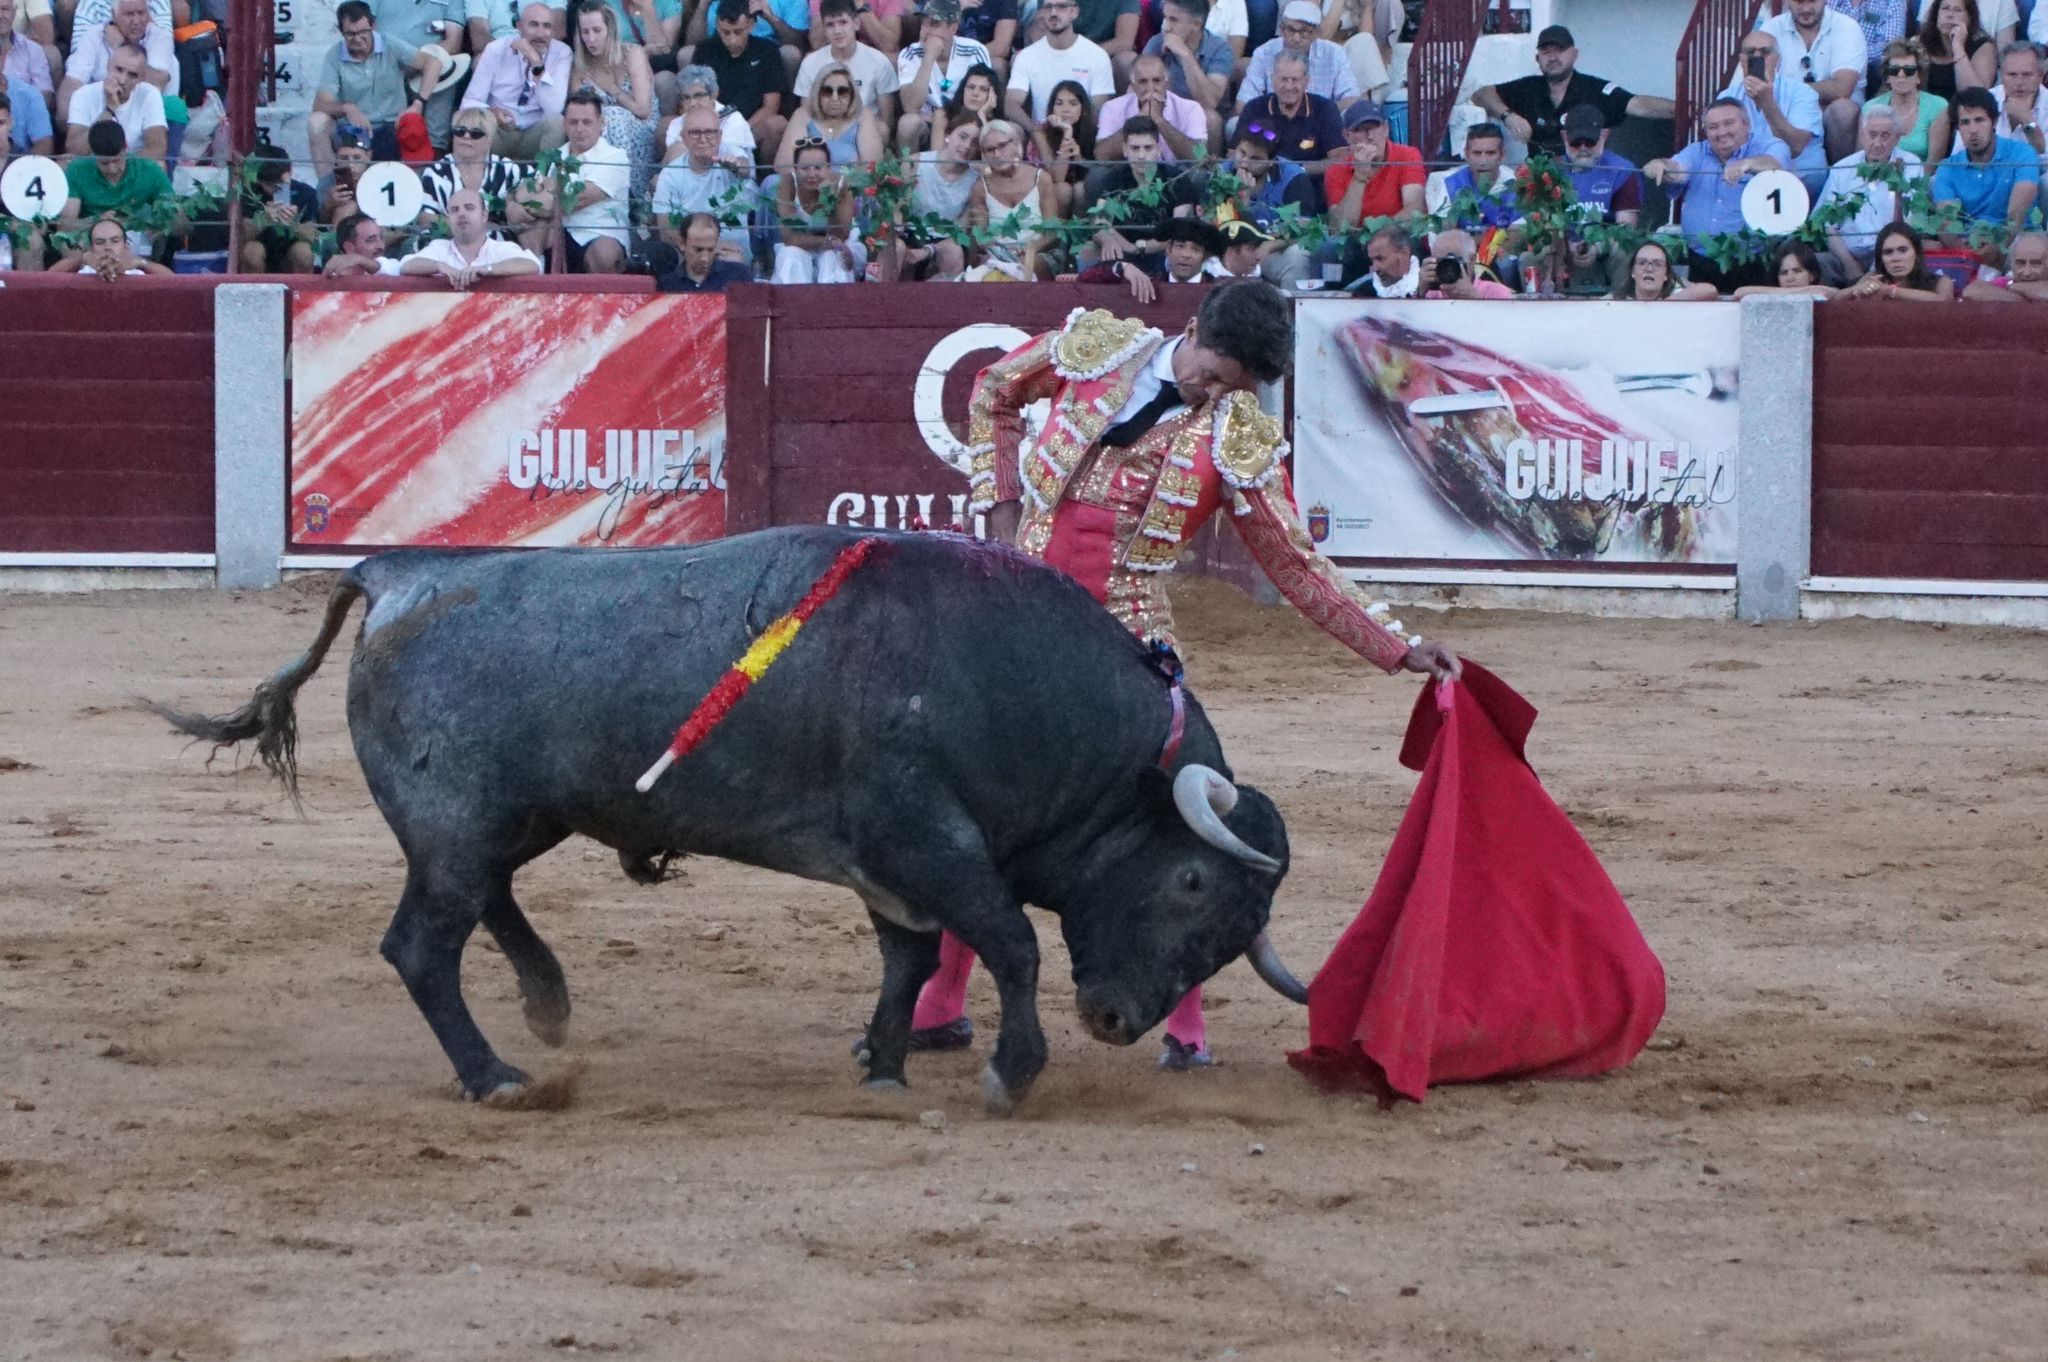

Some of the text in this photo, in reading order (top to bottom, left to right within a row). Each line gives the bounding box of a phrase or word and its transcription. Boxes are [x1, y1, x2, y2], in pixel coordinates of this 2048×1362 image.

[274, 2, 292, 22] 5
[25, 175, 46, 201] 4
[381, 182, 396, 206] 1
[1766, 188, 1782, 214] 1
[1505, 439, 1737, 503] GUIJUELO
